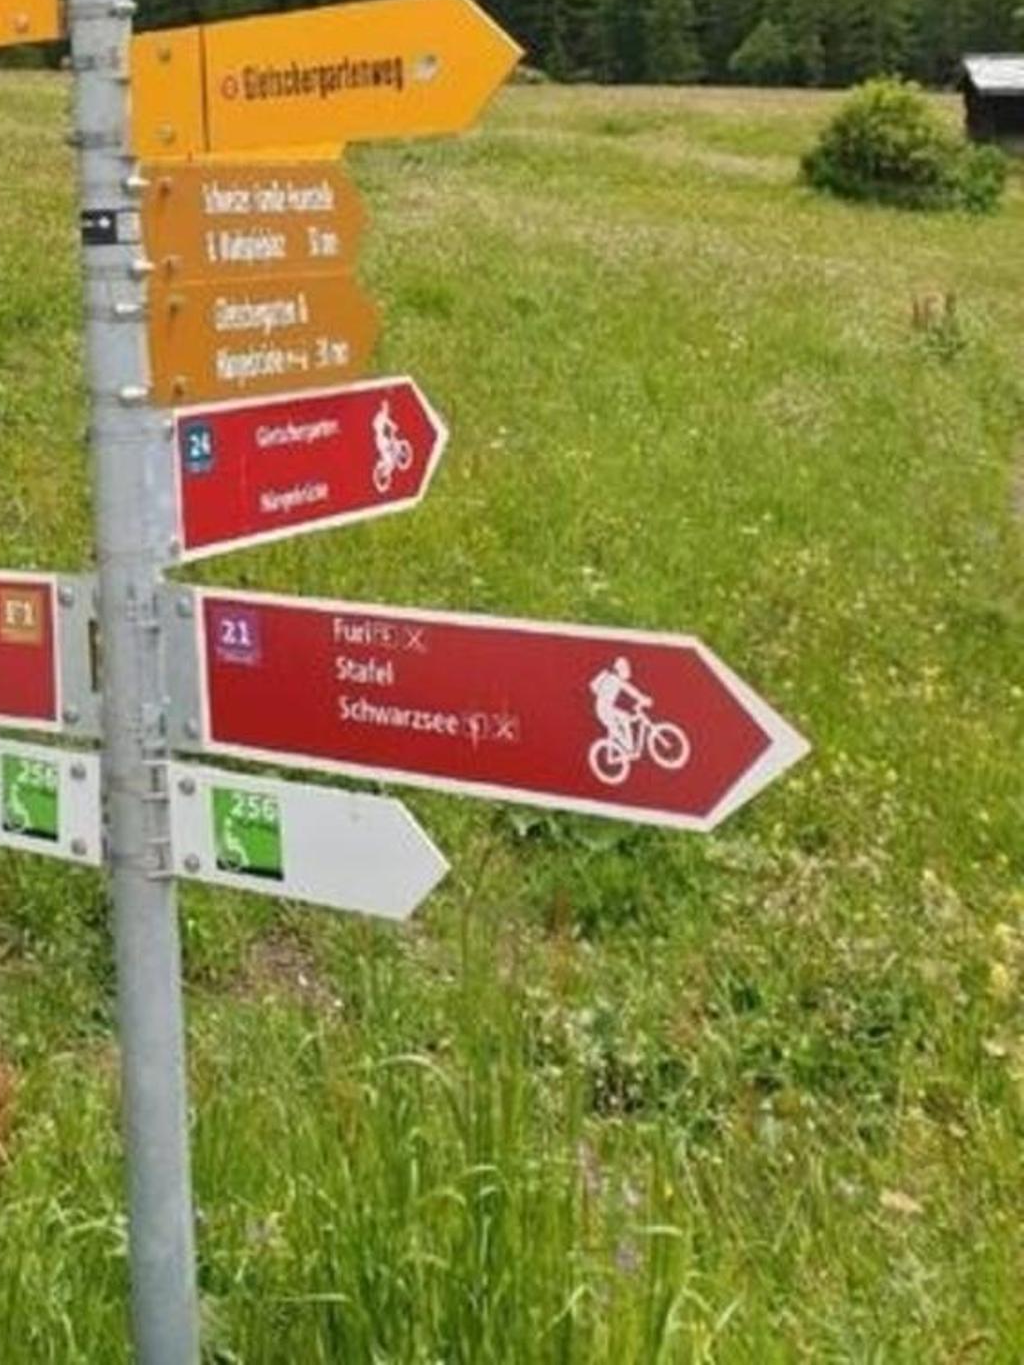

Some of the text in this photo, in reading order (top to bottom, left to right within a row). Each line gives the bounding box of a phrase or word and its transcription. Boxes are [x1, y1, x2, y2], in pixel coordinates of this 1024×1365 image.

[221, 617, 373, 647] 21 Furi
[335, 656, 394, 687] Stafel
[338, 695, 460, 733] Schwarzsee
[230, 793, 276, 820] 256
